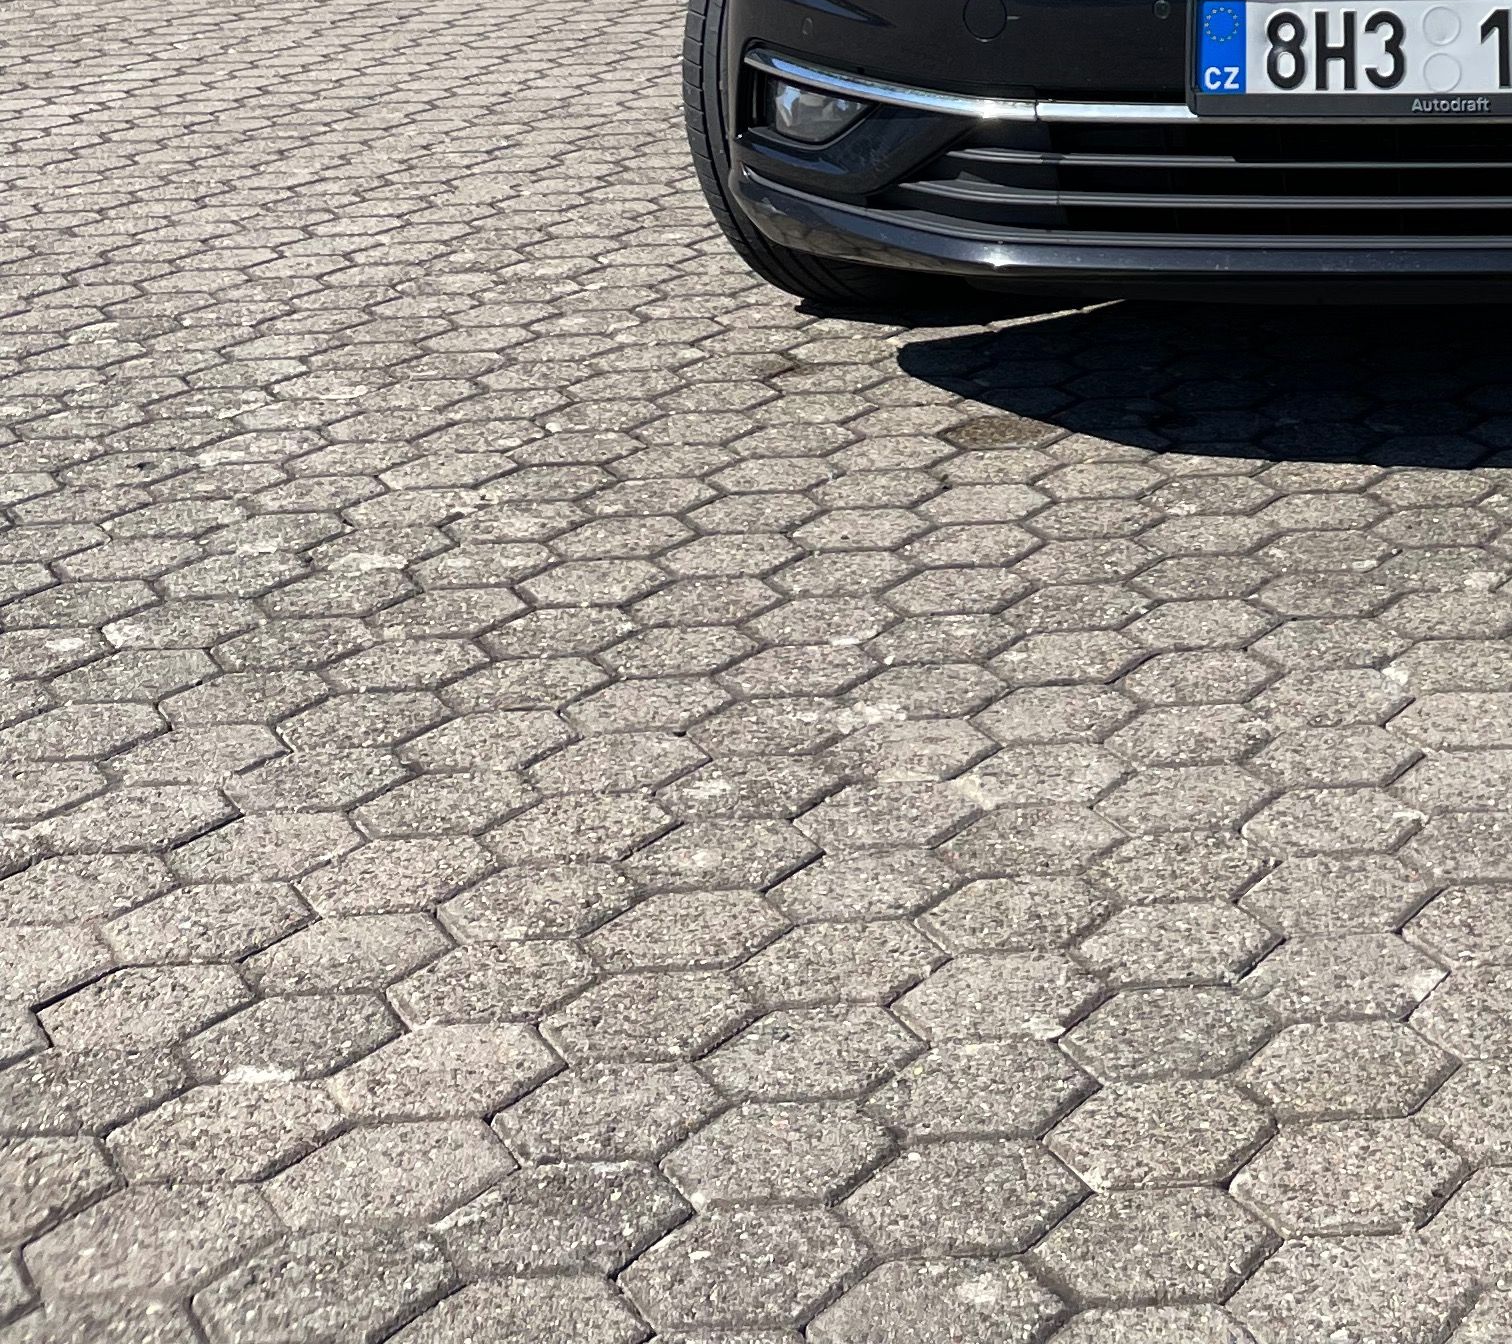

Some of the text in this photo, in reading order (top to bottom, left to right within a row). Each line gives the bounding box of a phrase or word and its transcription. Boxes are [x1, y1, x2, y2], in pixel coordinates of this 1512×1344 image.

[1203, 66, 1240, 91] CZ
[1265, 9, 1407, 91] 8H3
[1411, 96, 1490, 112] Autodraft
